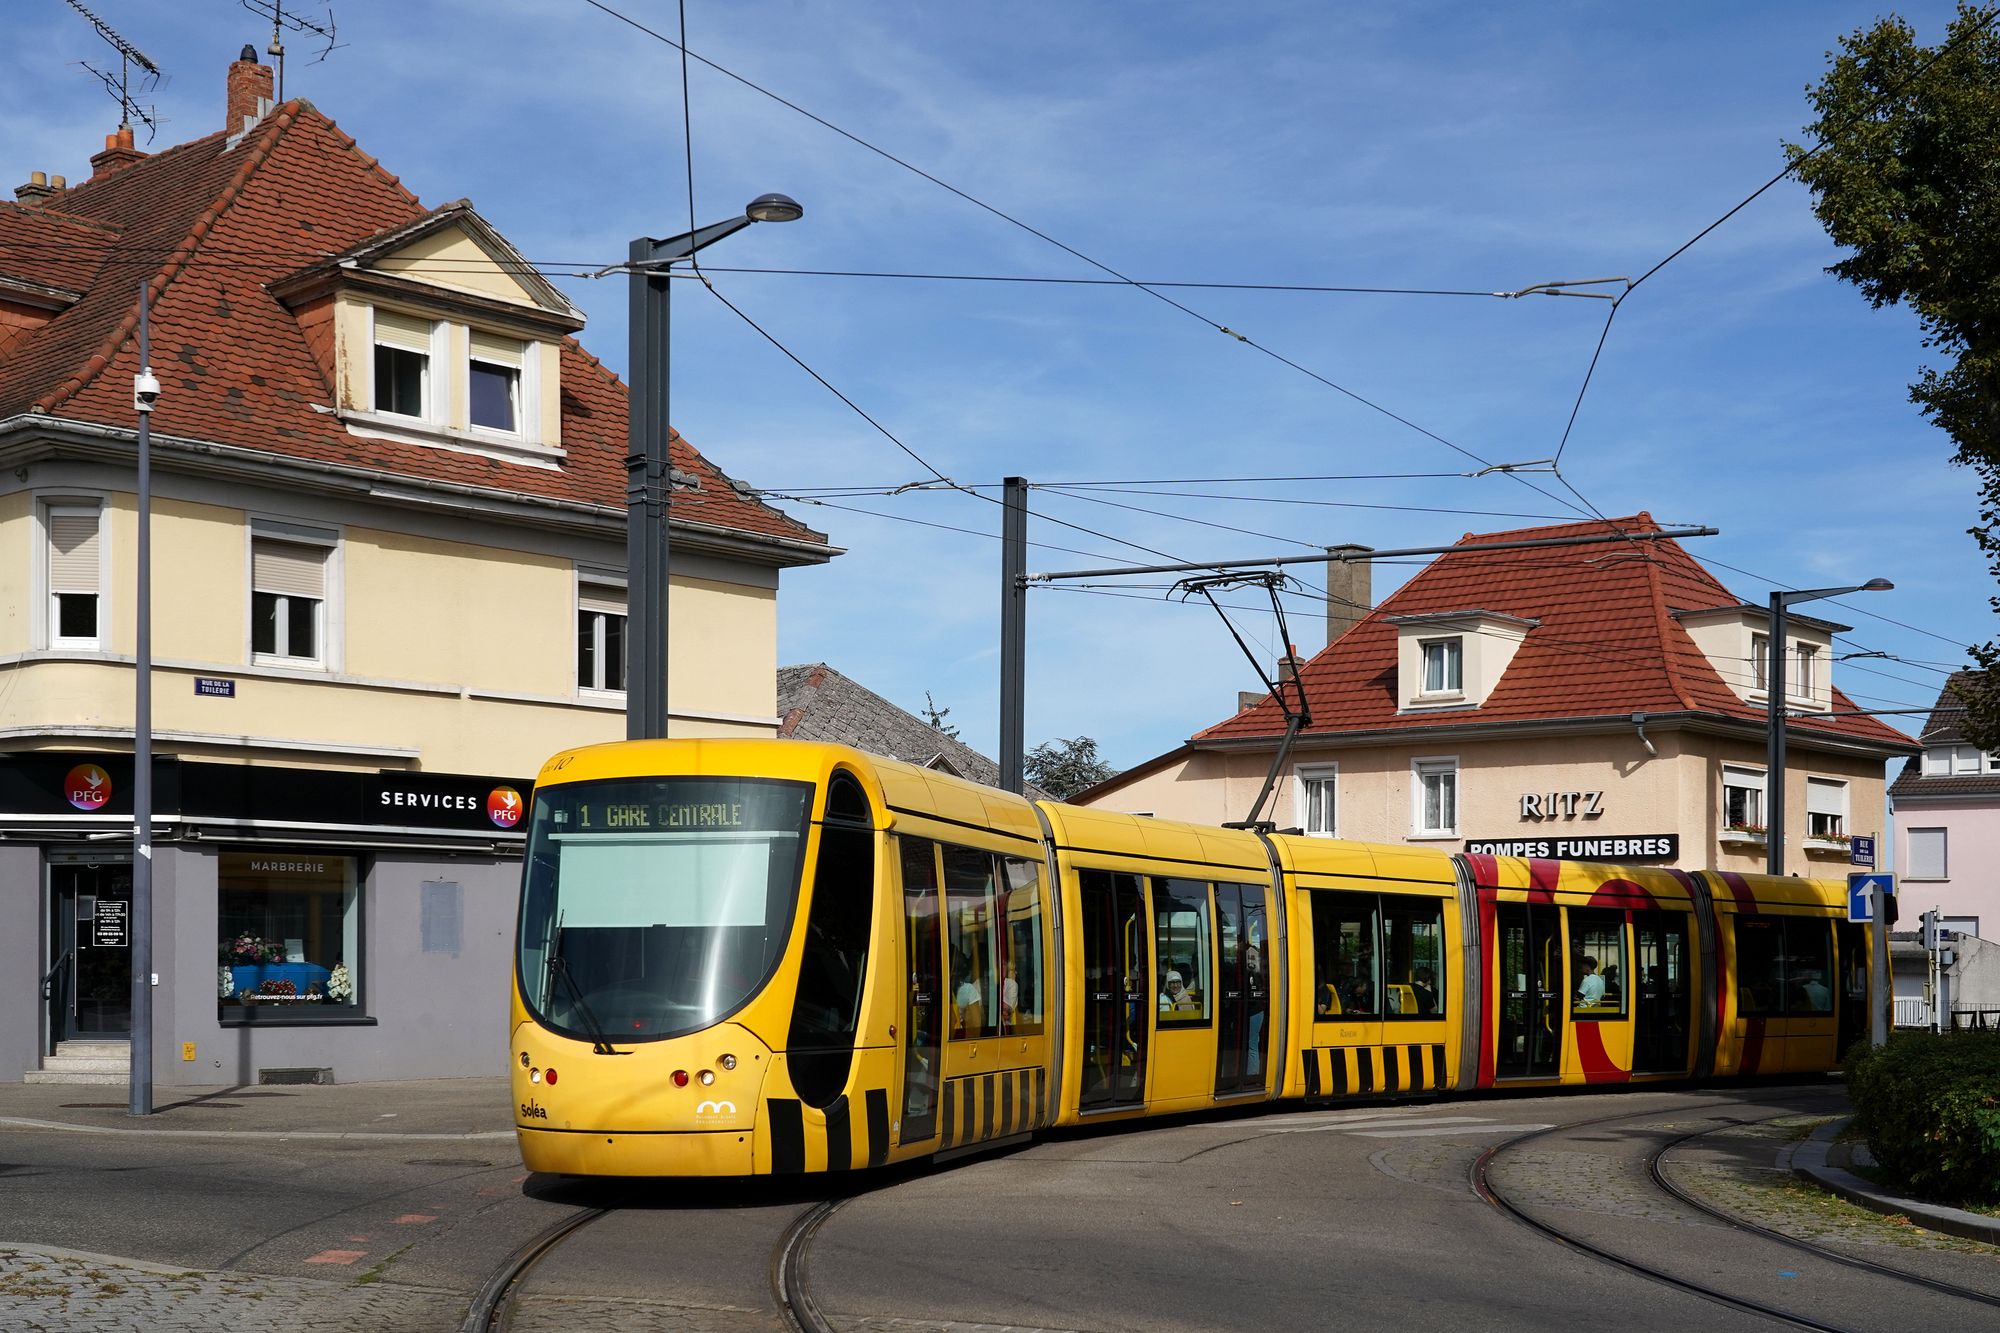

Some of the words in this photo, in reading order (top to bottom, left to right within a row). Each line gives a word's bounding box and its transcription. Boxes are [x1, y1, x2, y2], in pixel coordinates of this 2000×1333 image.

[202, 686, 230, 694] TUILERIE
[73, 790, 103, 803] PFG
[380, 791, 478, 810] SERVICES
[1520, 791, 1604, 817] RITZ
[493, 809, 517, 821] PFG
[580, 804, 591, 827] 1
[606, 803, 650, 827] GARE
[657, 803, 742, 827] CENTRALE
[1470, 841, 1549, 858] POMPES
[1556, 838, 1671, 857] FUNEBRES
[251, 861, 325, 873] MARBRERIE
